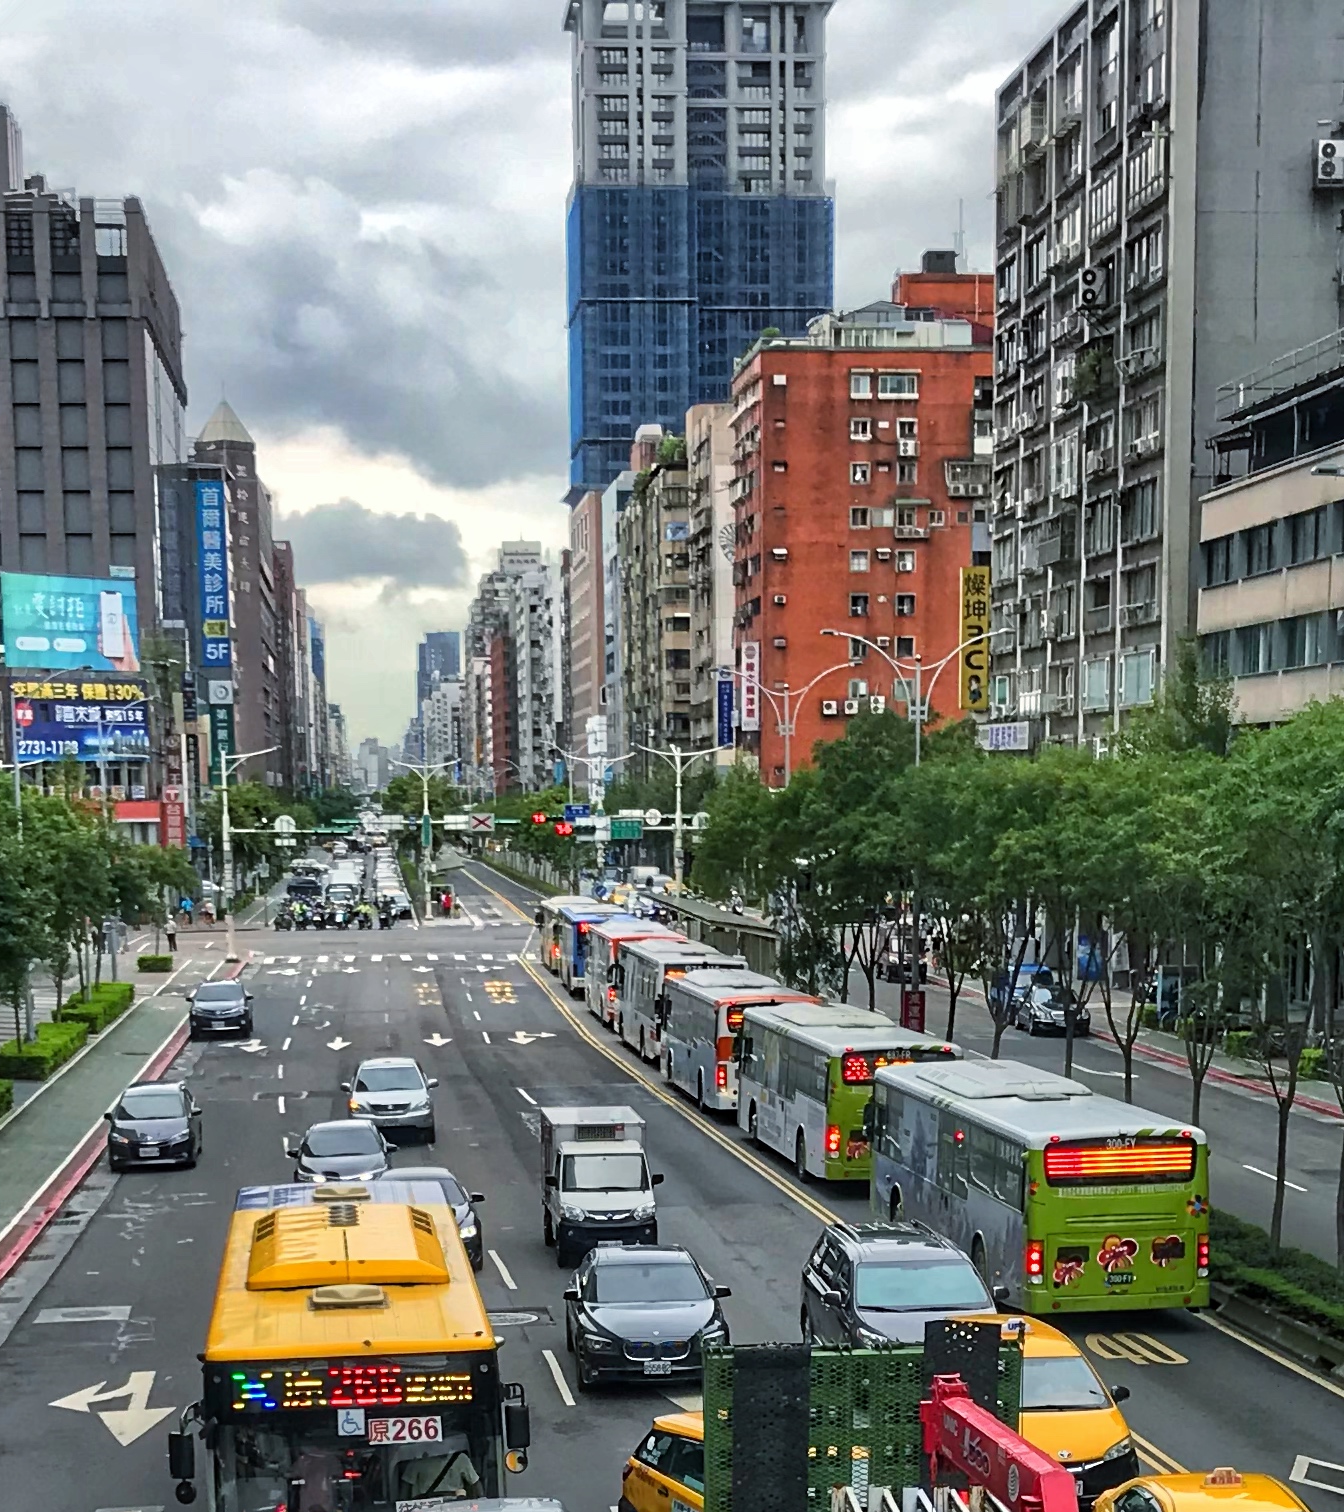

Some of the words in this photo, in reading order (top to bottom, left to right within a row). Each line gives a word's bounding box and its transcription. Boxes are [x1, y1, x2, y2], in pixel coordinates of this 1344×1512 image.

[200, 486, 225, 615] 首爾醫美診所
[206, 643, 229, 660] 5F
[1109, 1274, 1132, 1283] 300-FY
[1085, 1332, 1190, 1365] 40
